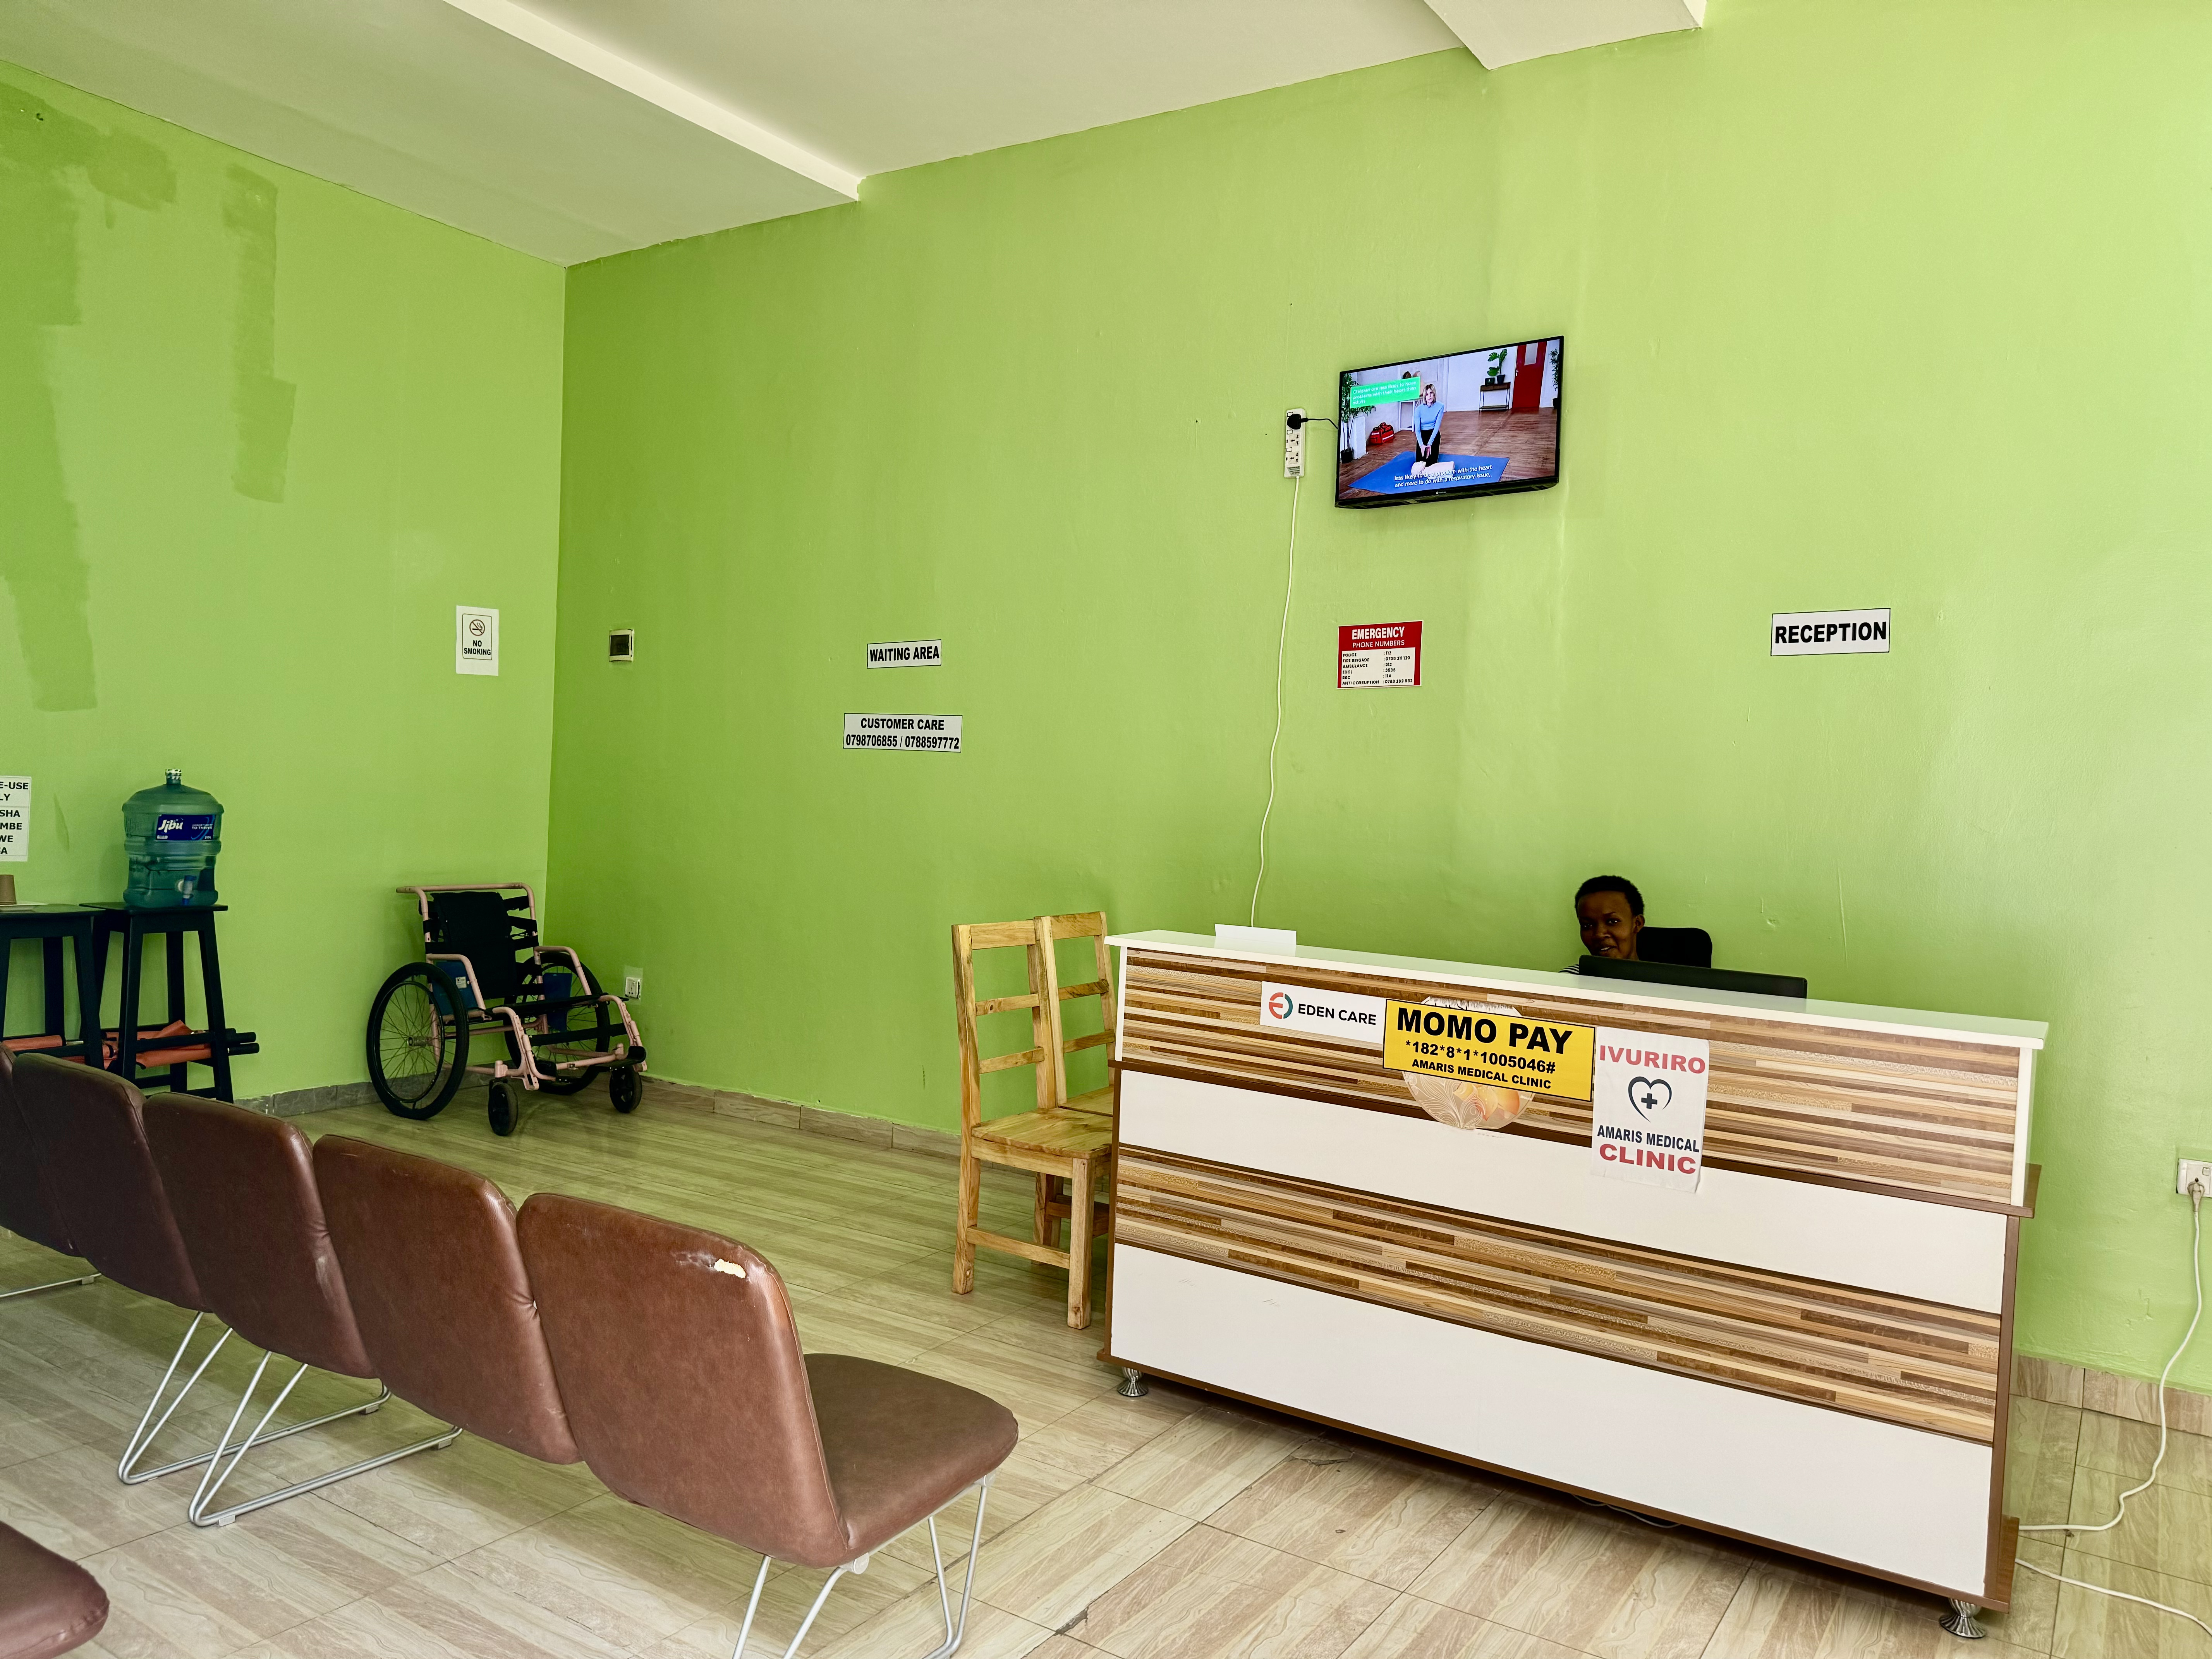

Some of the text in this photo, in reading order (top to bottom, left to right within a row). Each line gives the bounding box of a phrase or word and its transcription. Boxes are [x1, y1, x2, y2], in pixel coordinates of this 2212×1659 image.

[1352, 626, 1405, 640] EMERGENCY
[1775, 621, 1887, 644] RECEPTION
[464, 647, 491, 656] SMOKING
[869, 646, 939, 662] WAITING AREA
[860, 718, 945, 730] CUSTOMER CARE
[846, 734, 959, 749] 0798706855 / 0788597772
[158, 819, 184, 833] Jibu
[1298, 1003, 1376, 1025] EDEN CARE
[1397, 1007, 1573, 1054] MOMO PAY
[1599, 1045, 1706, 1074] IVURIRO
[1412, 1058, 1551, 1089] AMARIS MEDICAL CLINIC
[1597, 1125, 1699, 1153] AMARIS MEDICAL
[1599, 1143, 1697, 1175] CLINIC
